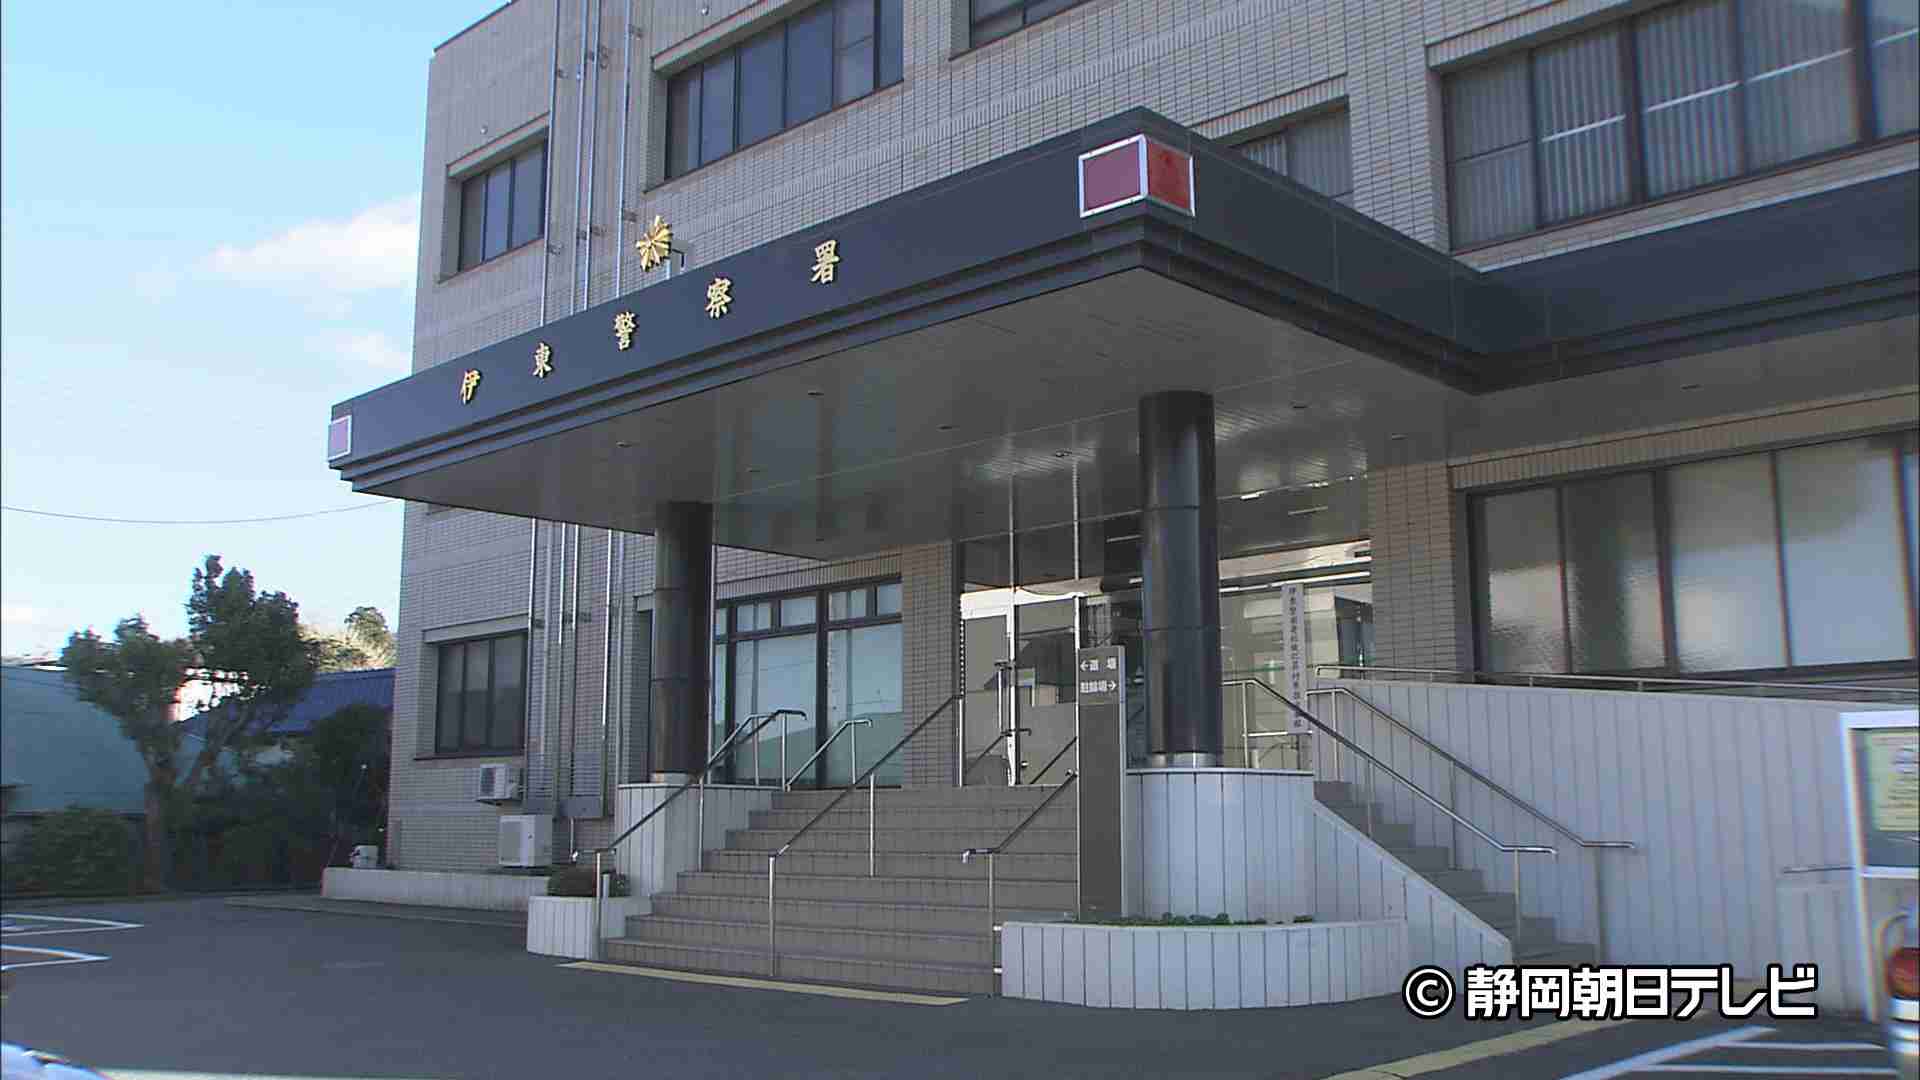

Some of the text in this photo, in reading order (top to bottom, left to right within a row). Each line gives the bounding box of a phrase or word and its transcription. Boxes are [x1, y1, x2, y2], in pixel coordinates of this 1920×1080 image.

[460, 240, 840, 404] 伊東警察署
